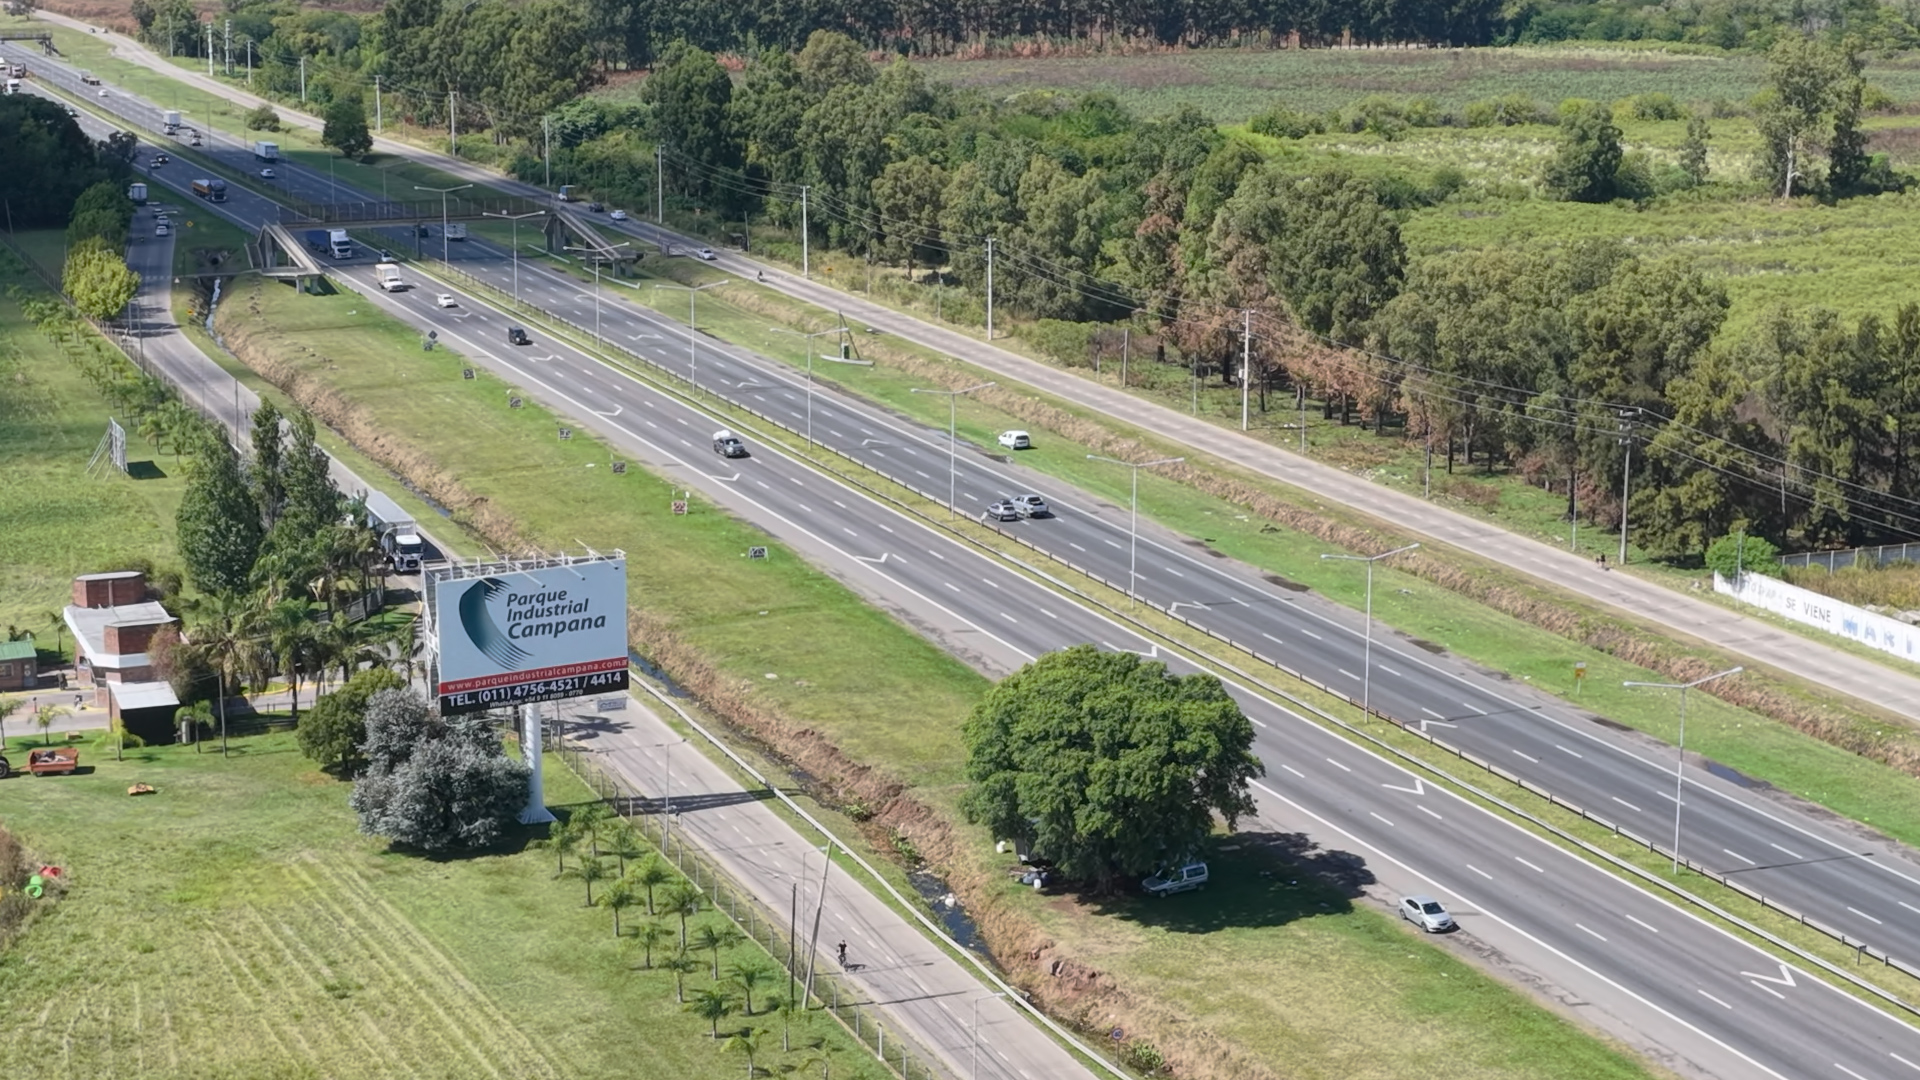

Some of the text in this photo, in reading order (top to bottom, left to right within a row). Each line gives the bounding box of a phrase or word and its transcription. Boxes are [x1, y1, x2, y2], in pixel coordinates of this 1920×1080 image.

[507, 590, 567, 607] Parque
[507, 598, 589, 622] Industrial
[1785, 597, 1796, 611] SE
[1804, 602, 1832, 623] VIENE
[508, 615, 606, 639] Campana
[448, 672, 621, 707] TEL. (011) 4756-4521 / 4414
